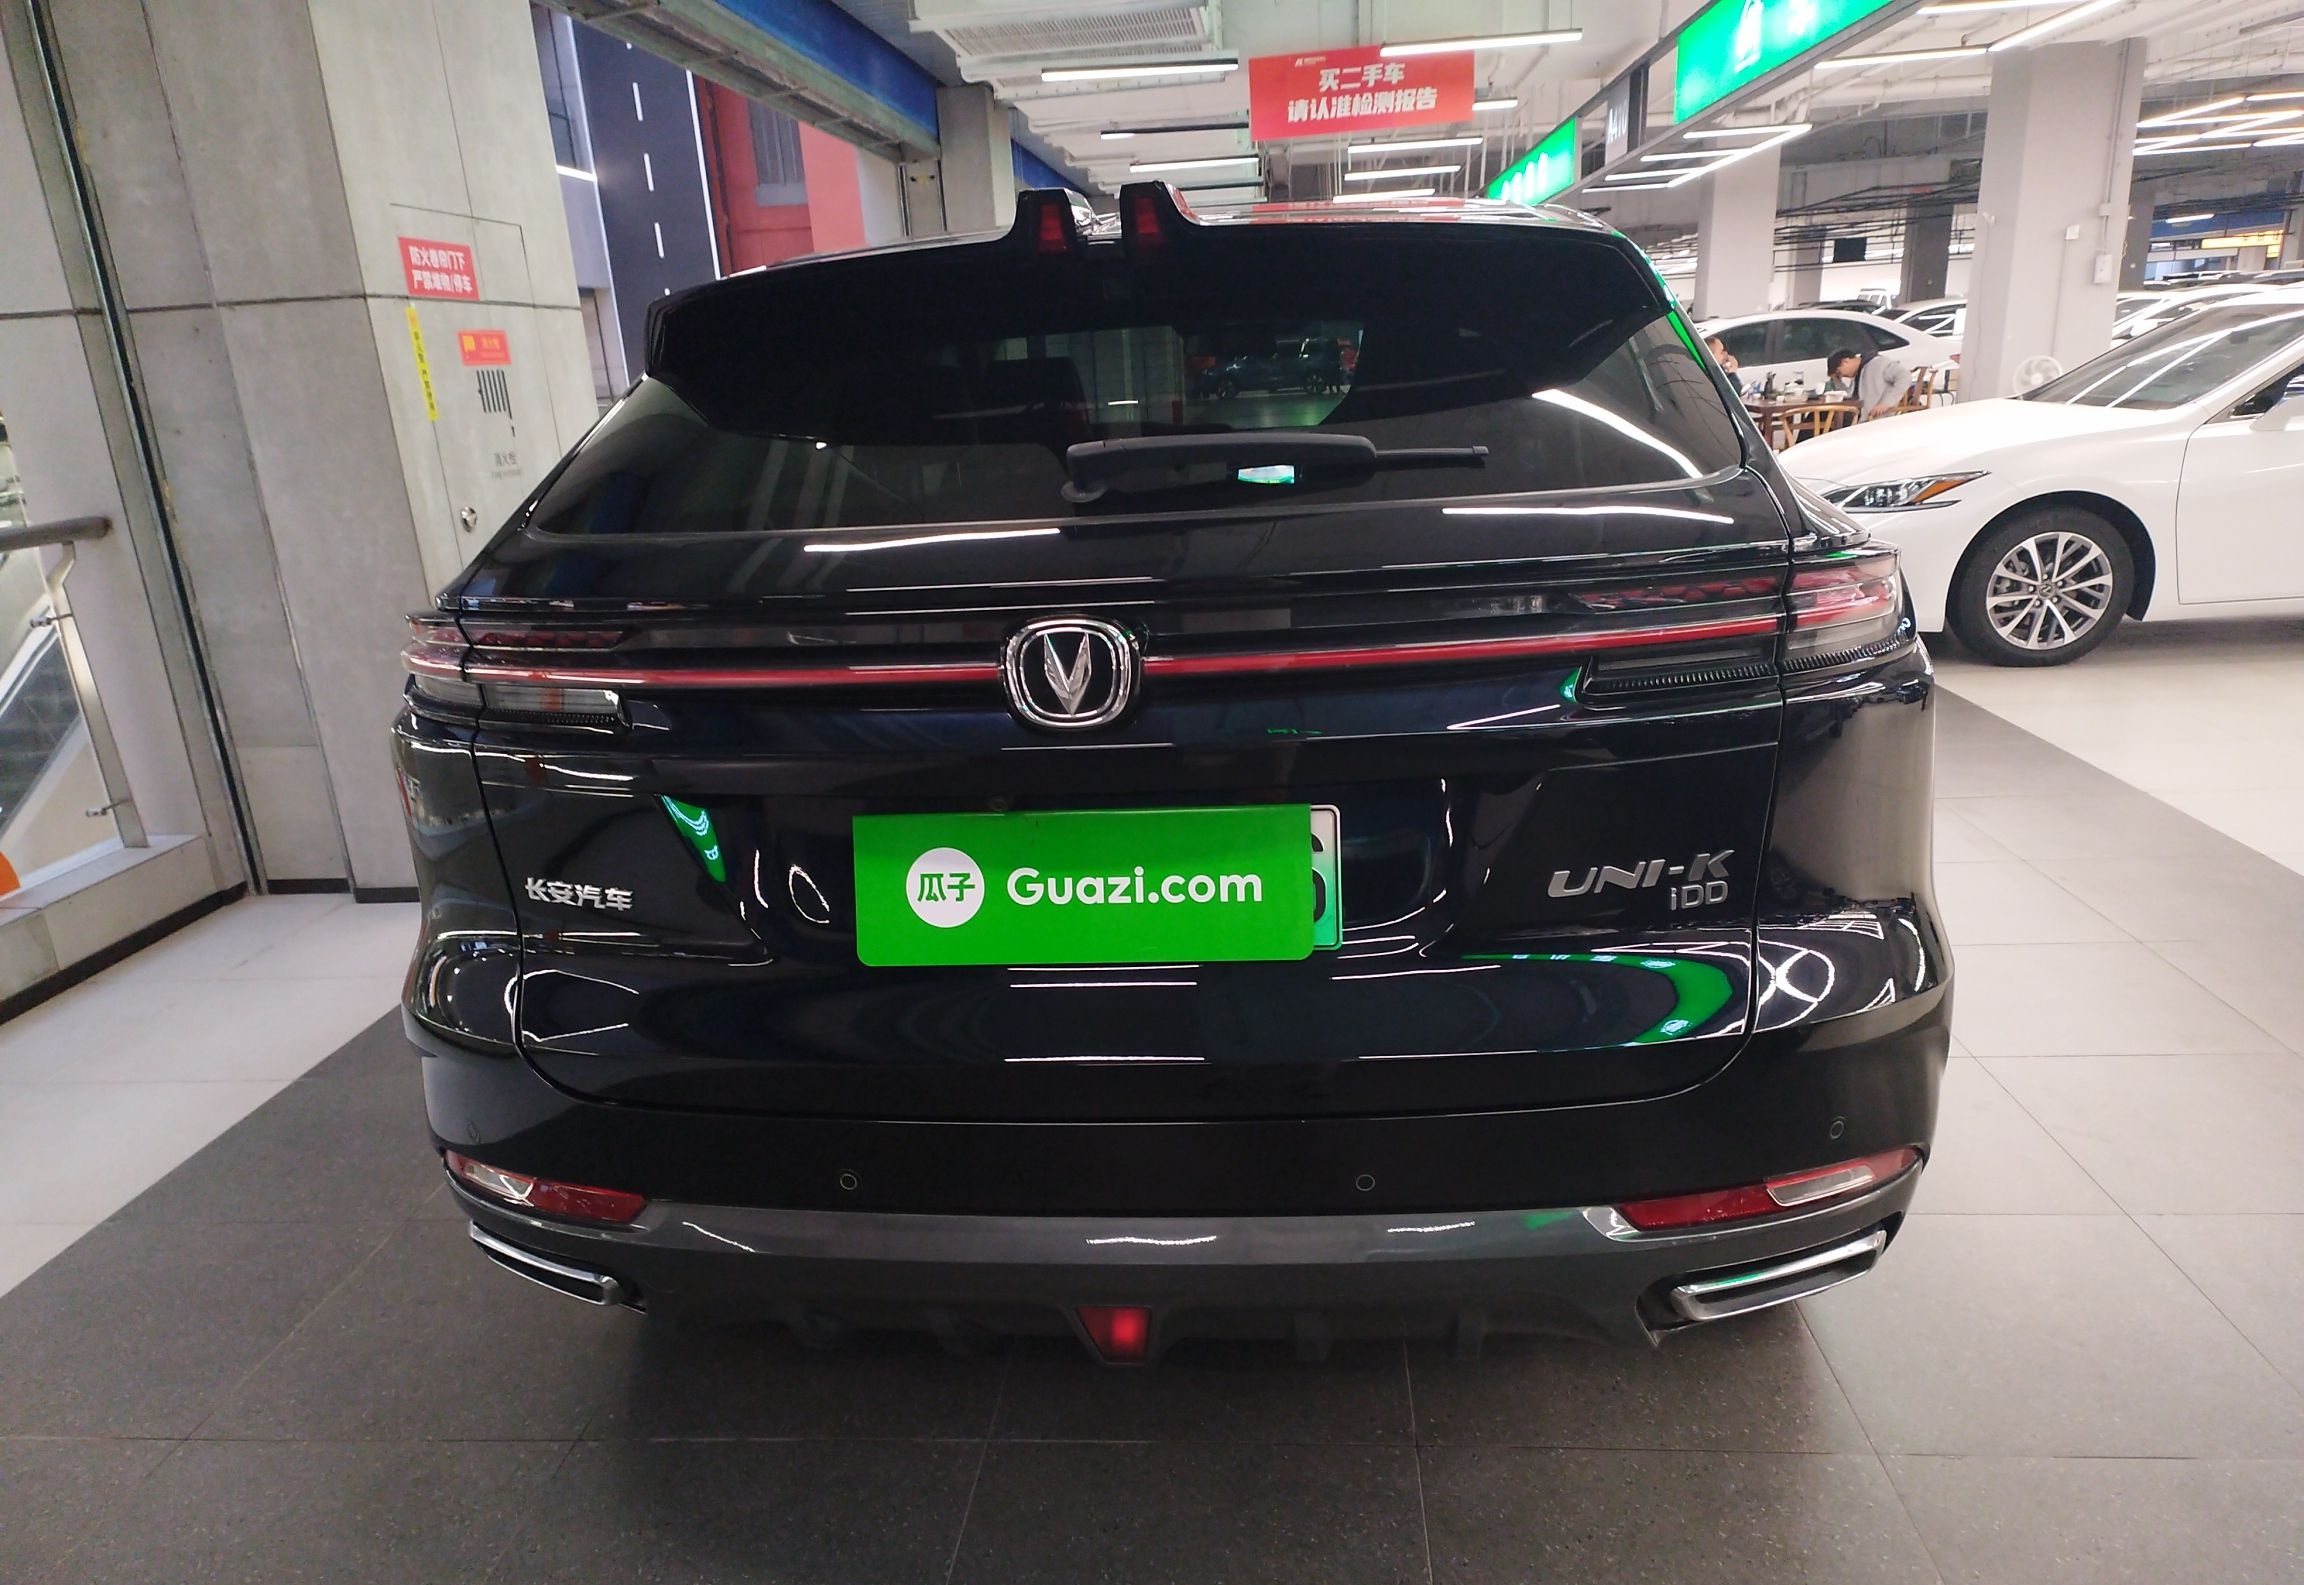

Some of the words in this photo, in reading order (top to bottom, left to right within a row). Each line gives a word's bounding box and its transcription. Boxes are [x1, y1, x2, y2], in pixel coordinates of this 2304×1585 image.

[1319, 62, 1406, 92] 买二手车
[1287, 86, 1438, 123] 请认准检测报告
[917, 872, 976, 902] 瓜子
[1006, 865, 1263, 906] Guazi.com
[1547, 849, 1736, 898] UNI-K
[524, 877, 634, 911] 长安汽车
[1670, 880, 1729, 911] iDD
